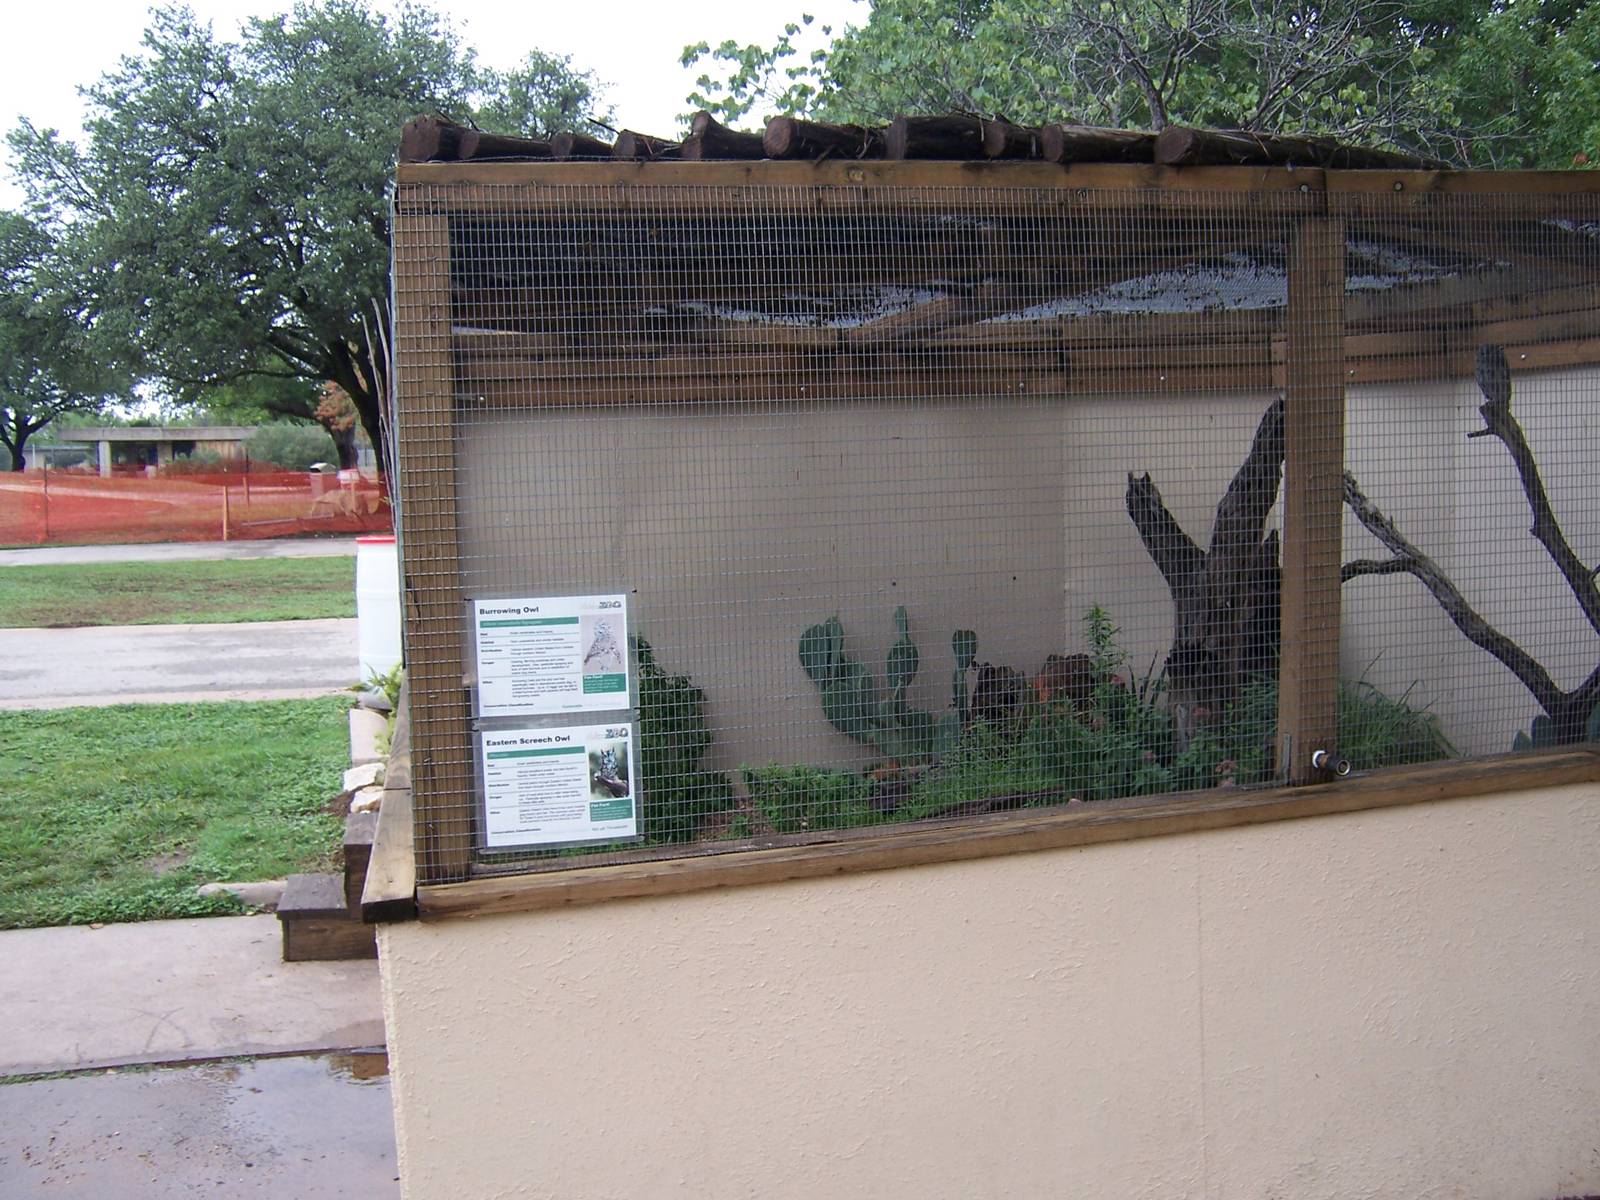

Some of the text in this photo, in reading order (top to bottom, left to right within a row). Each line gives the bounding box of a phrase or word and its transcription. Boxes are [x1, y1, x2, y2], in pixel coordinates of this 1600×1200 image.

[479, 607, 521, 615] Burrowing
[486, 735, 571, 747] Eastern Screech Owl
